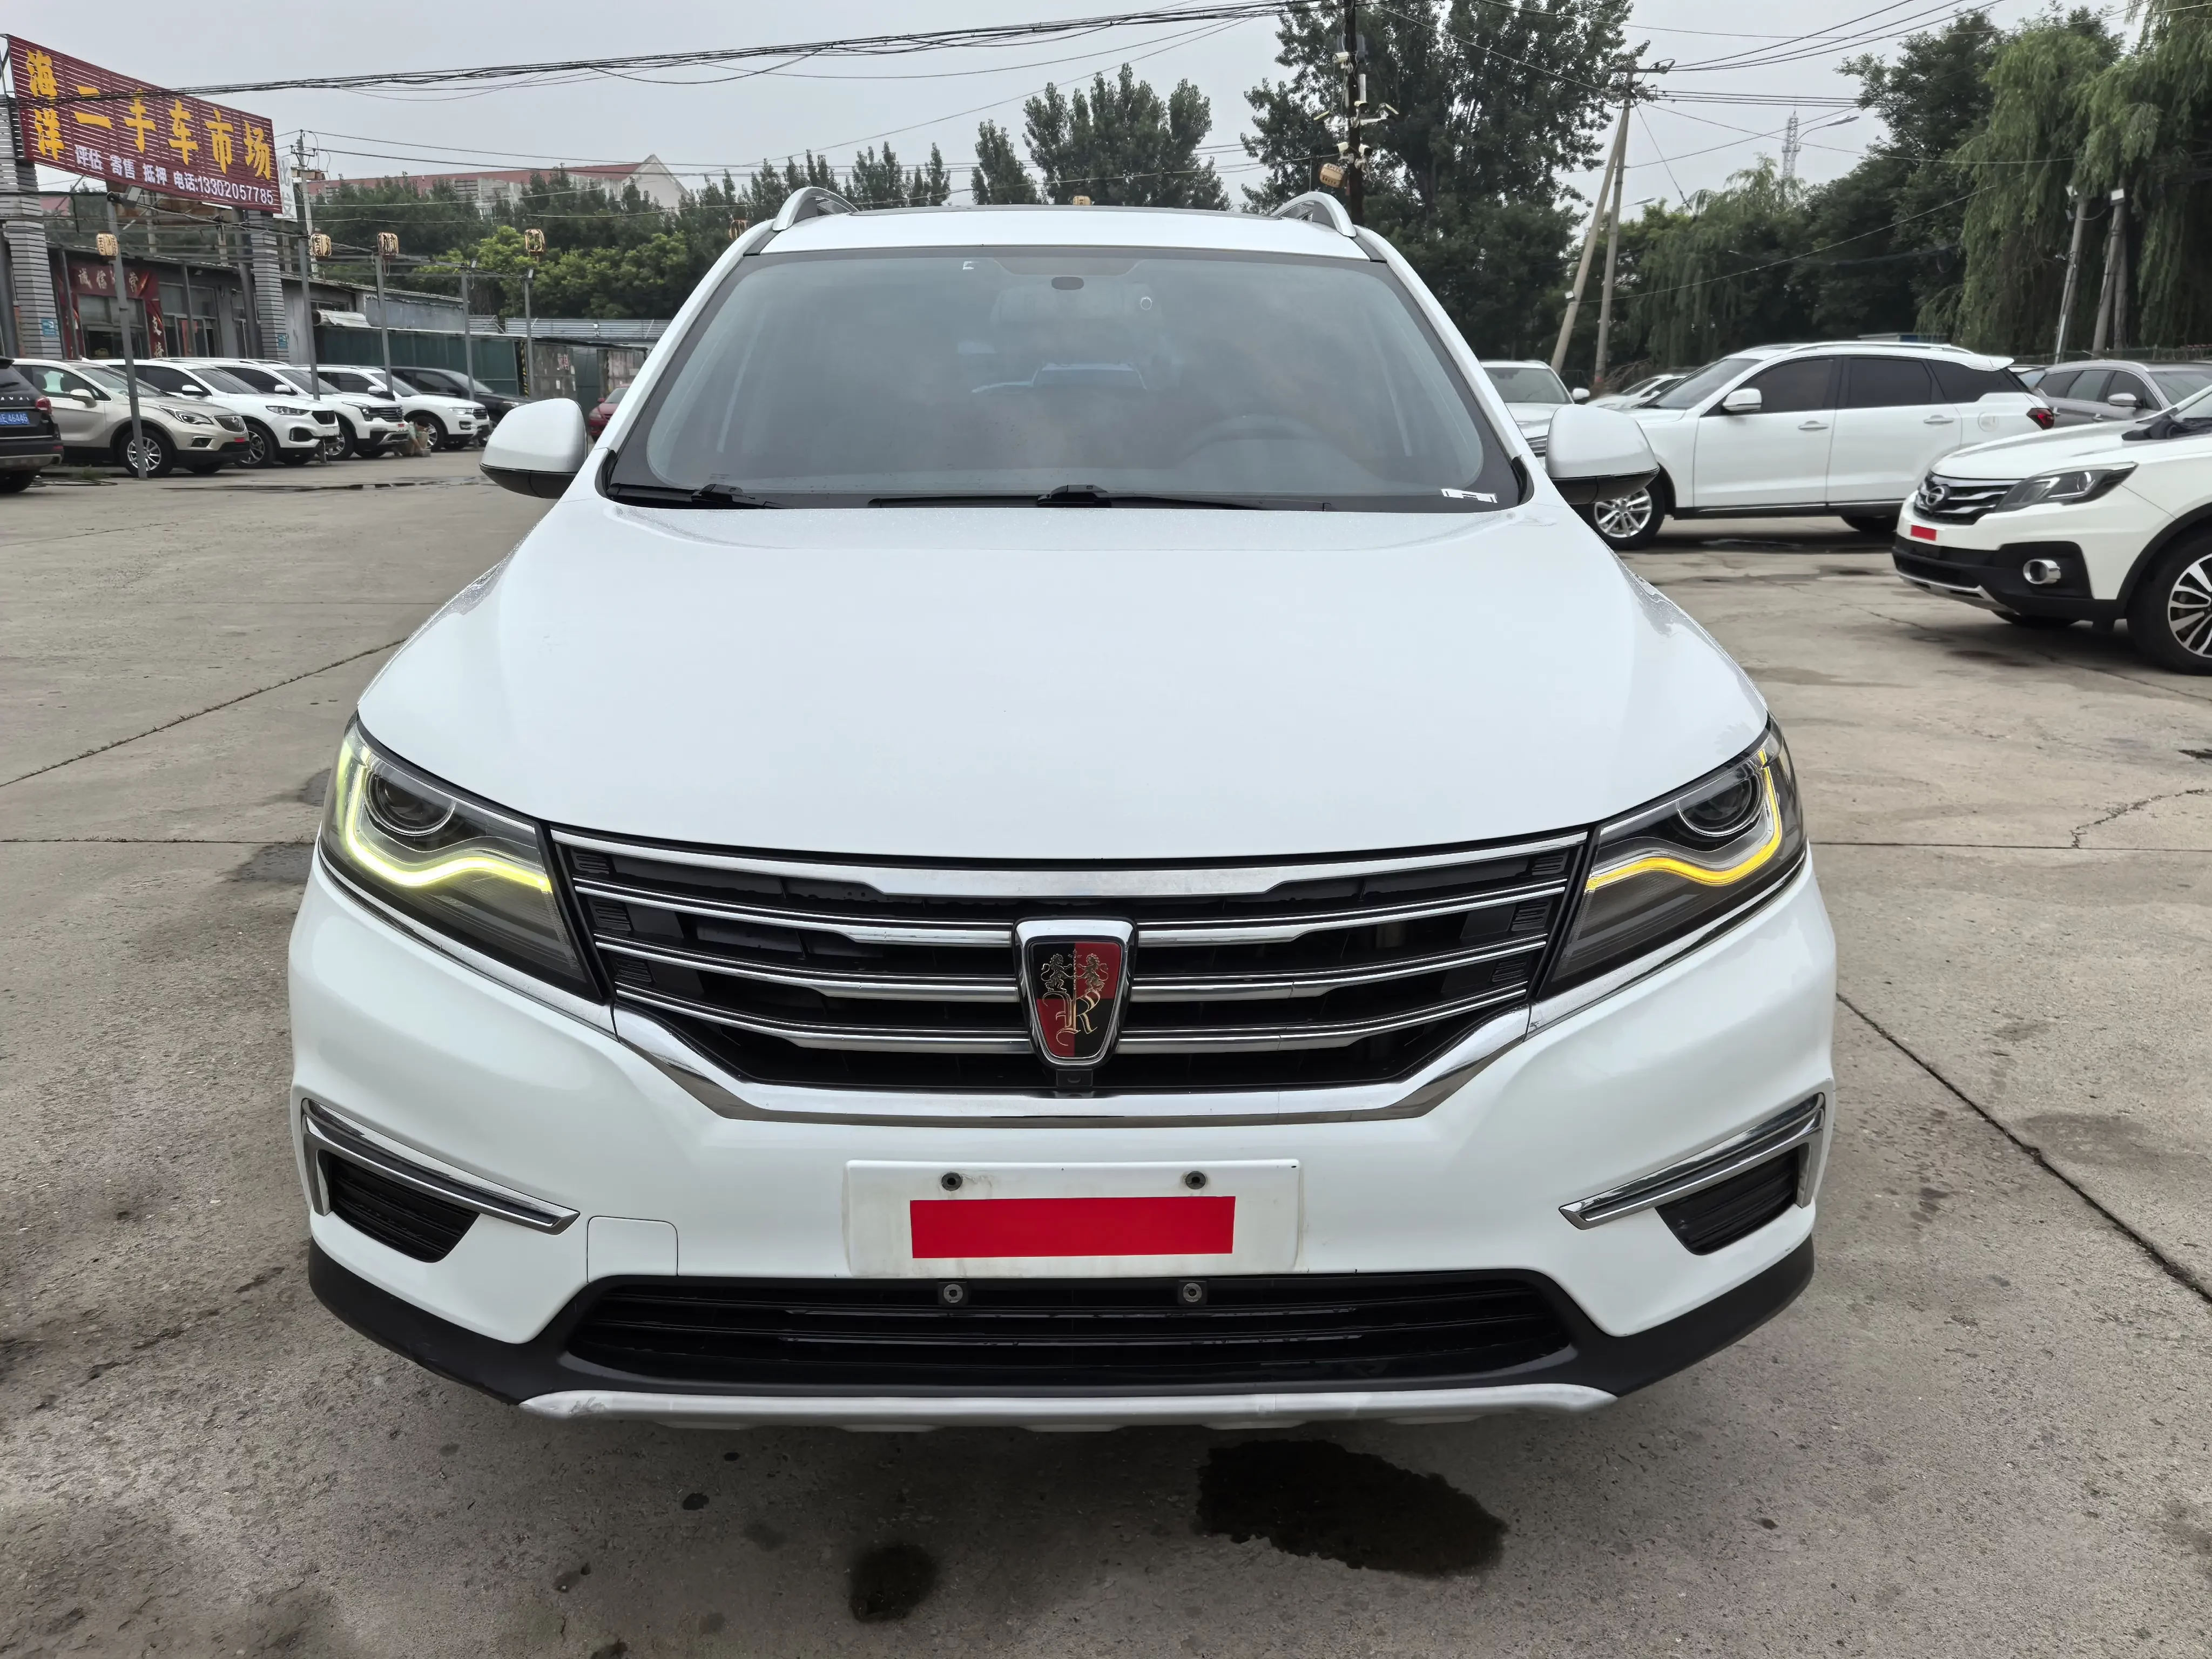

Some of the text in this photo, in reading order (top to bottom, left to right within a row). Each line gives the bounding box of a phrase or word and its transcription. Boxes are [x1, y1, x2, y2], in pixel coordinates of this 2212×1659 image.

[74, 85, 270, 180] 二手车市场
[74, 144, 104, 171] 评估
[110, 154, 136, 180] 寄售
[143, 163, 167, 186] 抵押
